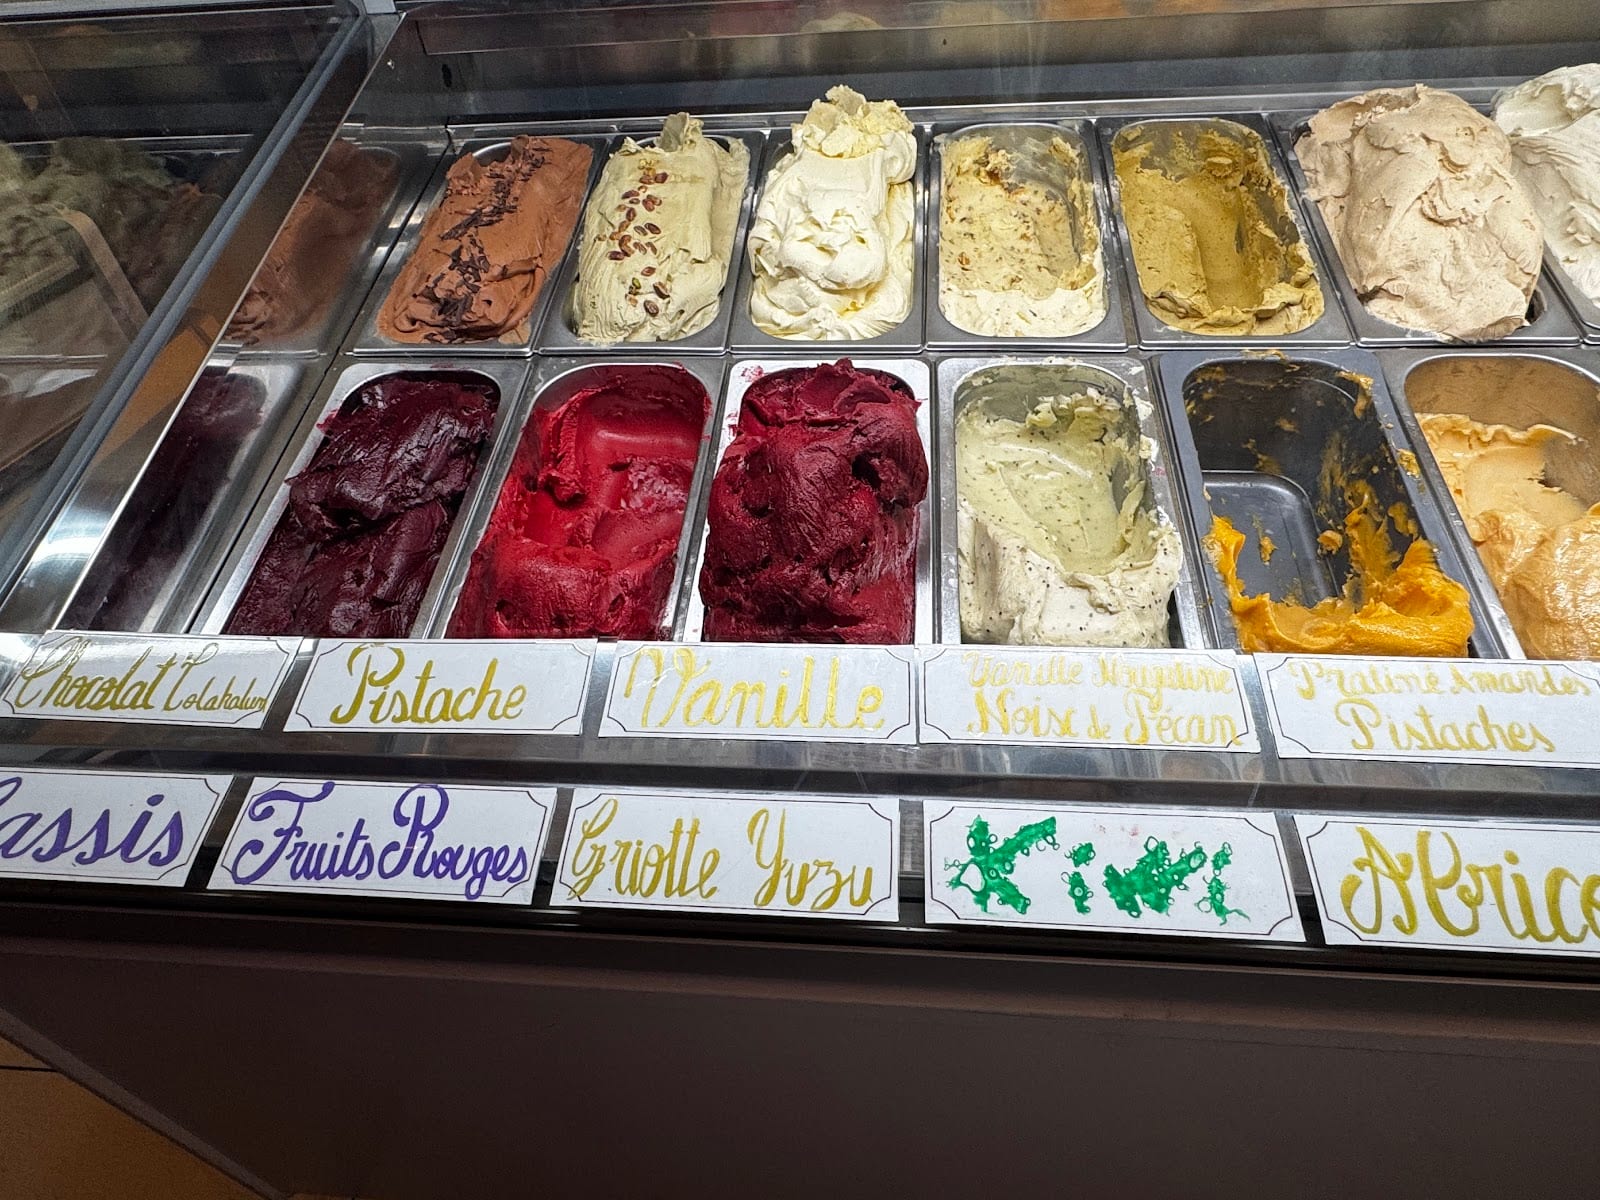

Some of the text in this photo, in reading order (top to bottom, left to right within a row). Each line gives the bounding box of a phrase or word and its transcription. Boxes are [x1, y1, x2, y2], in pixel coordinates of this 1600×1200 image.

[14, 636, 178, 711] Chocolat
[330, 642, 527, 724] Pistache
[624, 647, 885, 728] Vanille
[962, 650, 1084, 687] Vanille
[1449, 663, 1592, 697] Amandes
[966, 687, 1244, 745] Noix de Pécan
[1333, 698, 1556, 752] Pistaches
[0, 776, 184, 867] assis
[231, 781, 528, 900] Fruits Rouges
[567, 798, 874, 910] Griotte Yuzu
